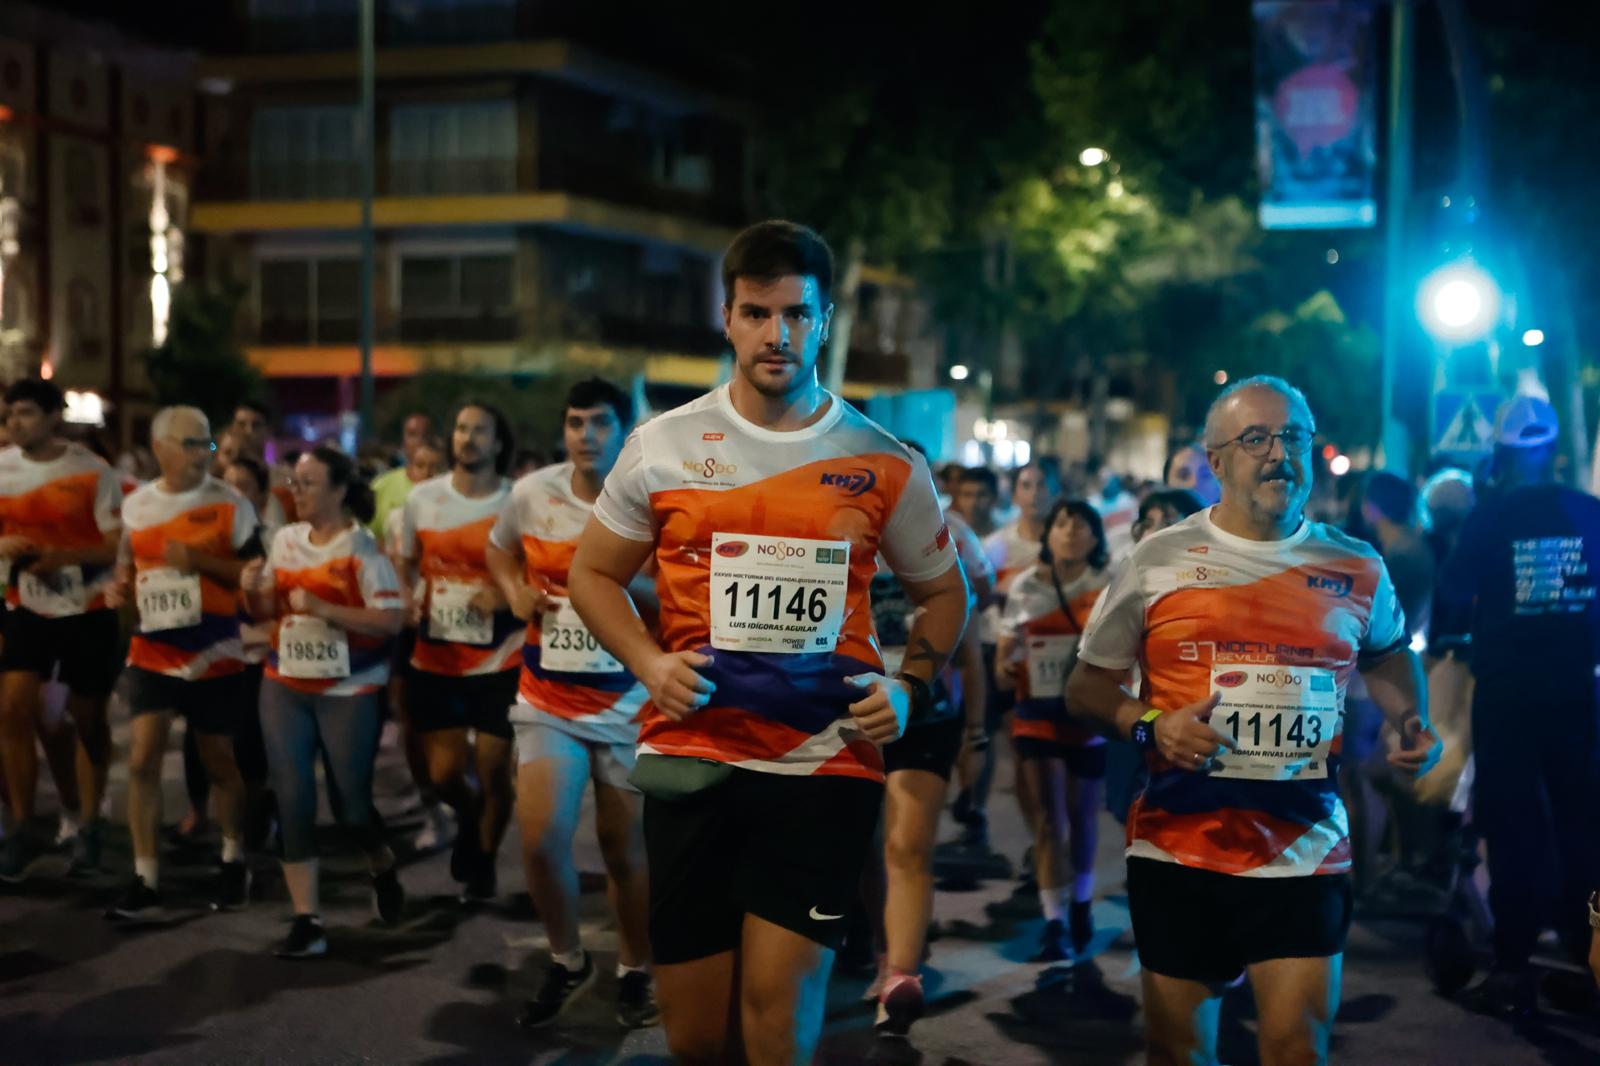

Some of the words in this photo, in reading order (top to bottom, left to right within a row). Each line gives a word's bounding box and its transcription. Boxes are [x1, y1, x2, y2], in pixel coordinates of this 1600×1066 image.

[143, 590, 192, 613] 17876
[725, 581, 828, 623] 11146
[729, 621, 746, 629] LUIS
[784, 624, 818, 633] AGUILAR
[287, 641, 338, 660] 19826
[1177, 641, 1216, 661] 37
[1217, 652, 1275, 663] SEVILLA
[1226, 711, 1322, 748] 11143
[1261, 750, 1284, 758] RIVAS
